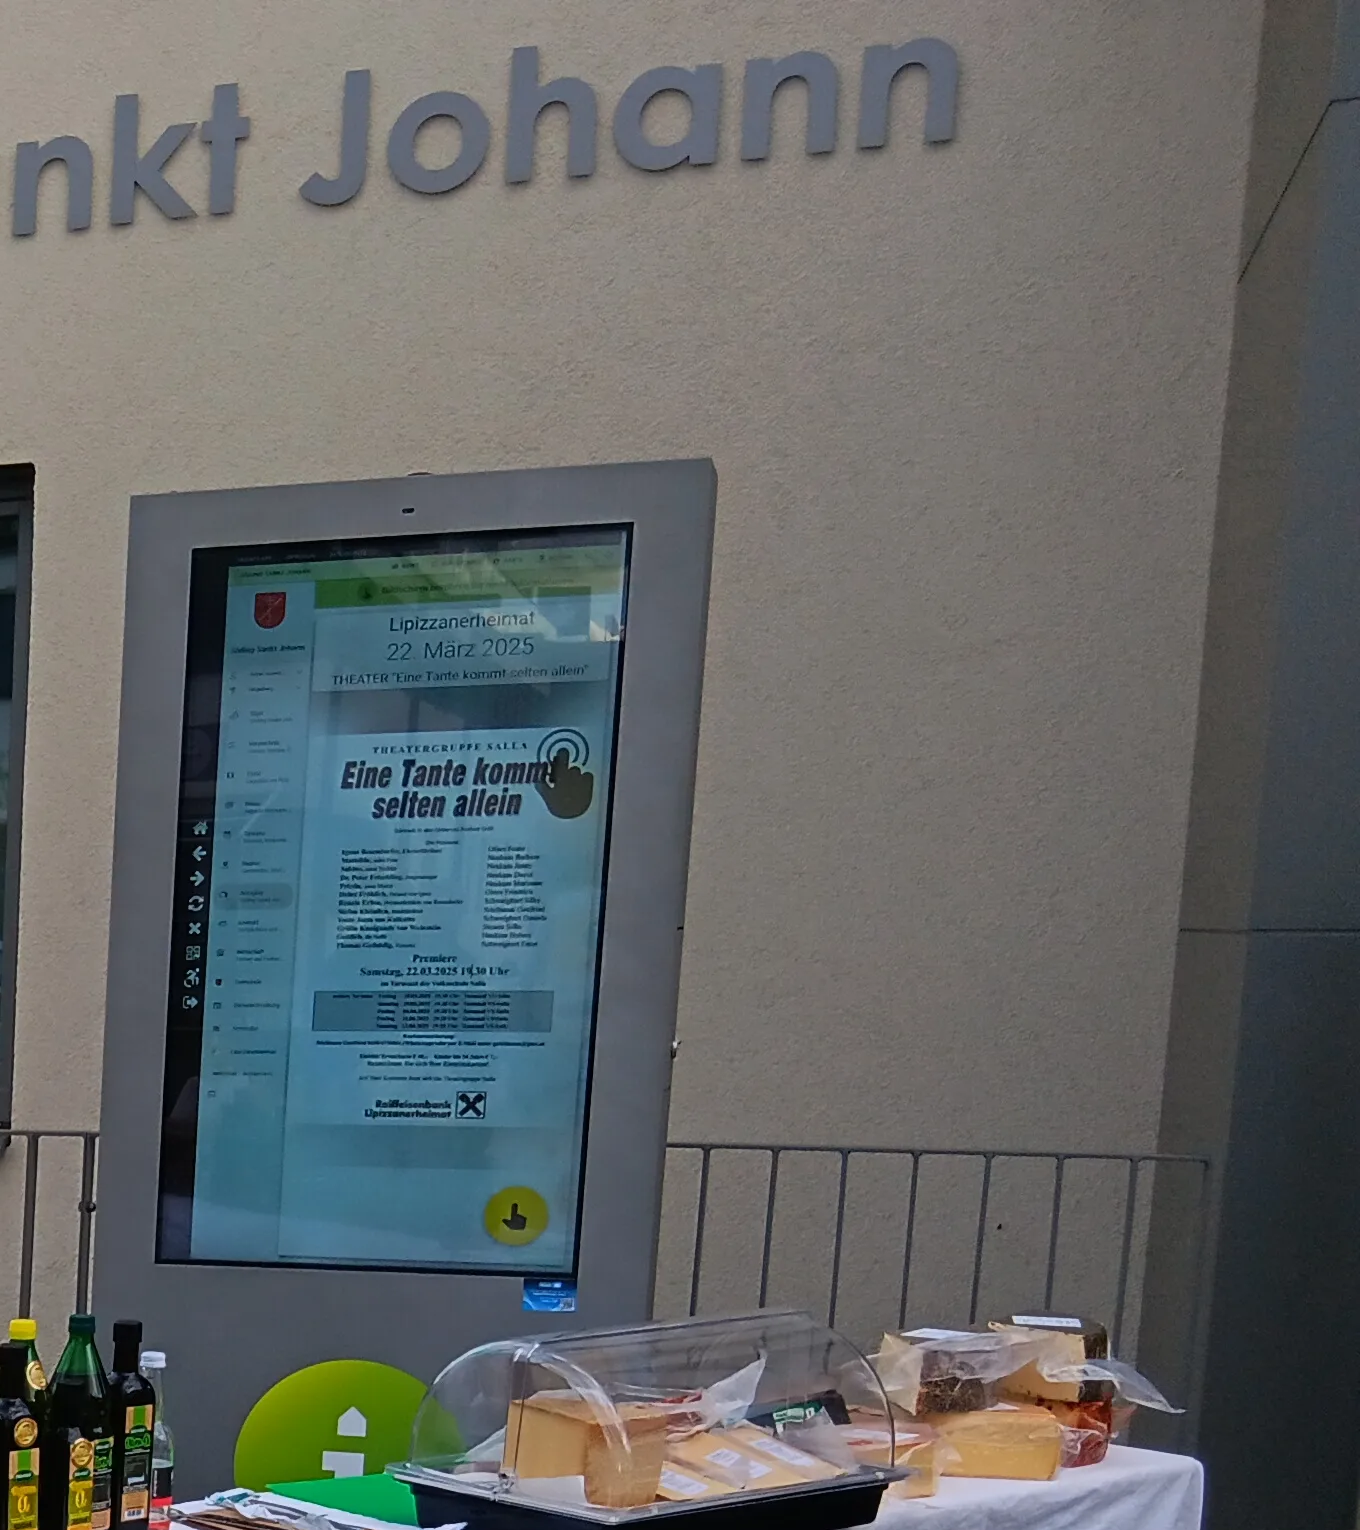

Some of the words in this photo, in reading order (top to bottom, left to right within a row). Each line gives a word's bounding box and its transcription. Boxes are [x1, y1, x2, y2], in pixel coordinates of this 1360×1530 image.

[299, 34, 962, 208] Johann
[388, 611, 536, 634] Lipizzanerheimat
[387, 642, 416, 662] 22.
[424, 637, 476, 660] März
[482, 637, 536, 659] 2025
[332, 671, 389, 687] THEATER
[425, 668, 460, 682] Tante
[462, 667, 507, 681] kommt
[486, 740, 528, 752] SALLA
[340, 760, 392, 789] Eine
[401, 758, 467, 788] Tante
[371, 790, 446, 820] selten
[452, 787, 523, 818] allein
[411, 953, 458, 965] Premiere
[488, 967, 510, 977] Uhr
[375, 1099, 452, 1110] Raiffeisenbank
